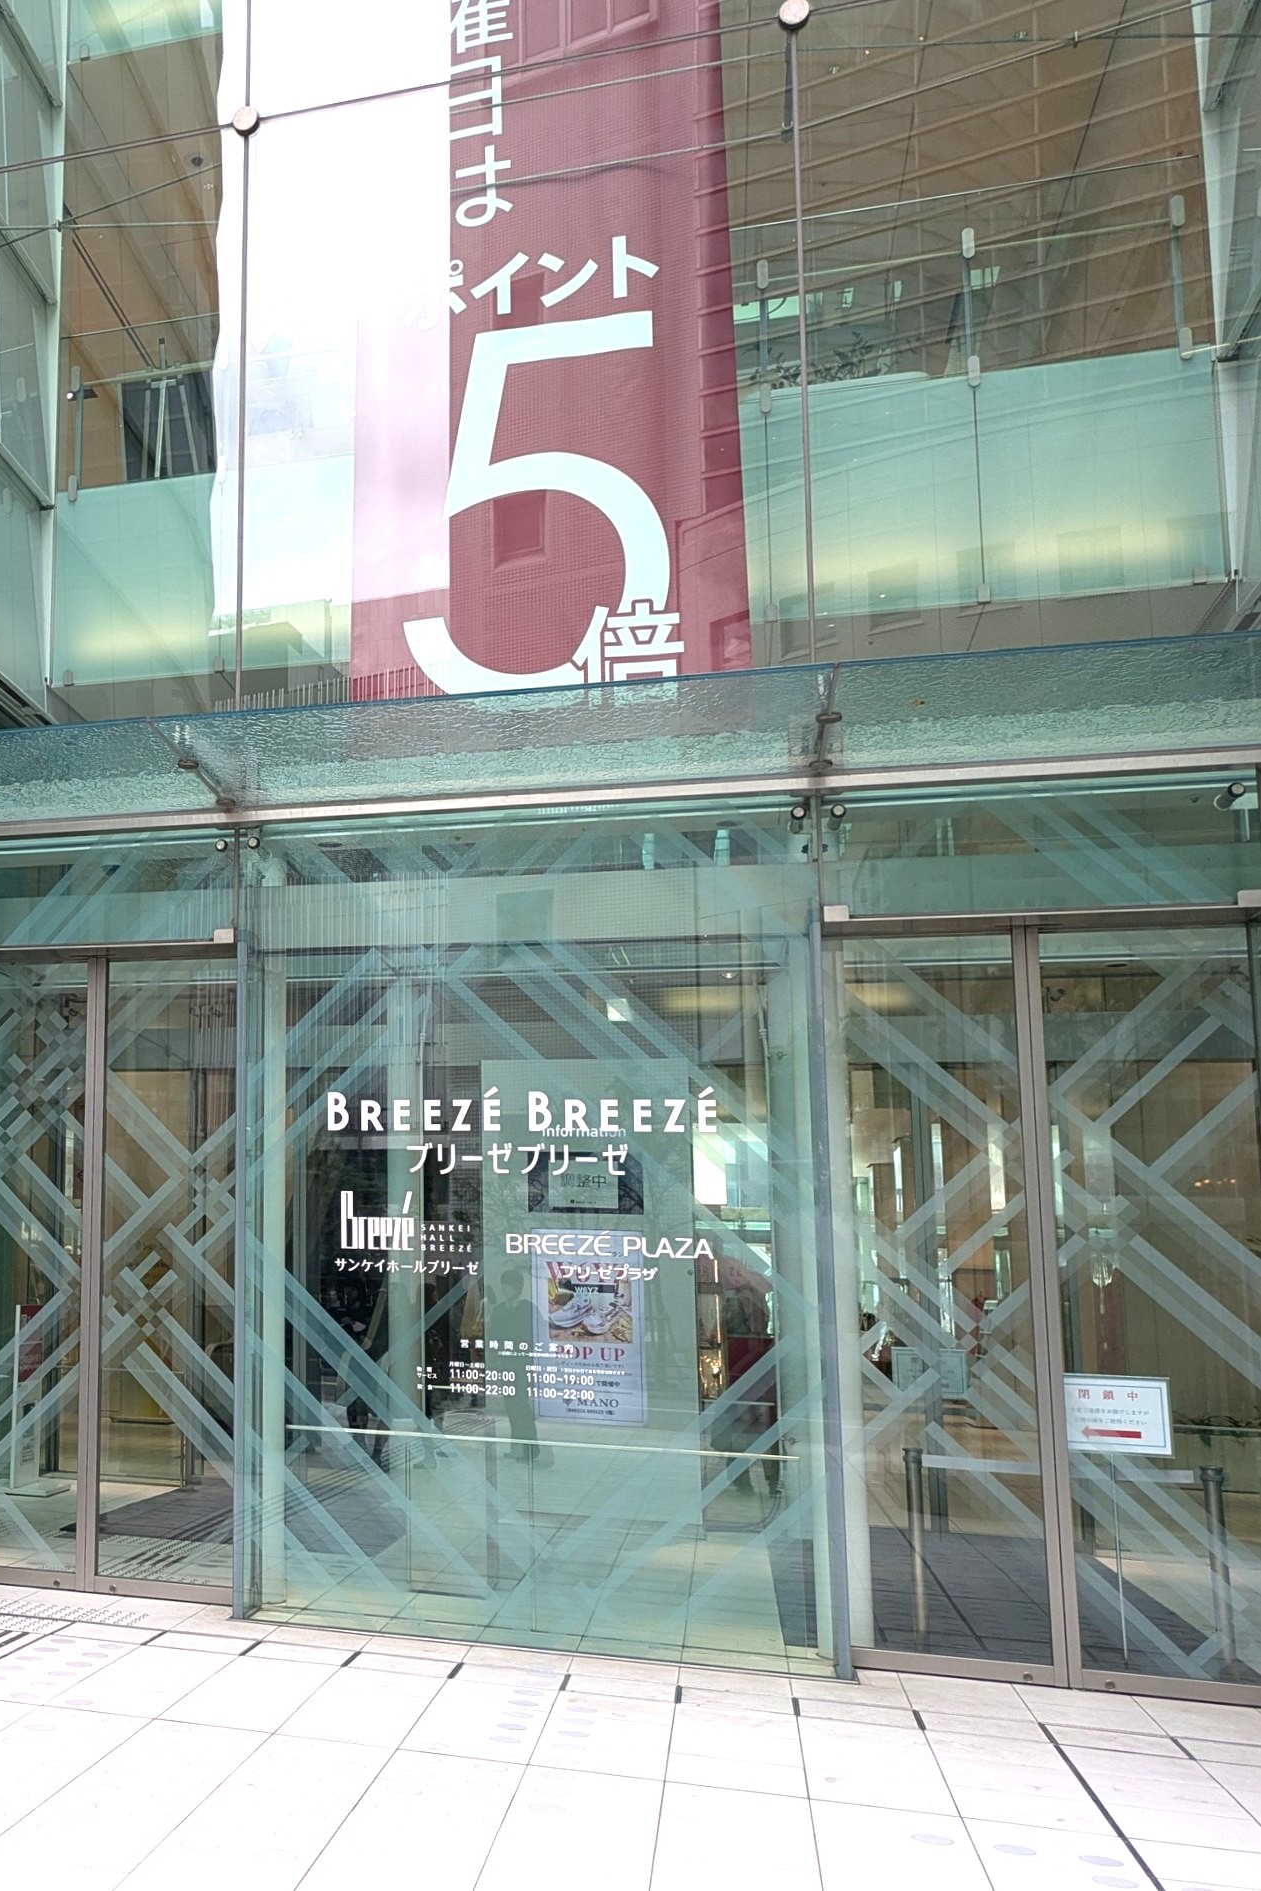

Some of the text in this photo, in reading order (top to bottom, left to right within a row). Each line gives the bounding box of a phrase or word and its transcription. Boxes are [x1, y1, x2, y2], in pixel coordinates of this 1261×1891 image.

[326, 1086, 718, 1133] BREEZÉ BREEZÉ
[406, 1142, 629, 1177] ブリーゼブリーゼ
[560, 1173, 607, 1189] 調整中
[420, 1223, 471, 1232] SANKEI
[420, 1234, 455, 1242] HALL
[505, 1230, 612, 1257] BREEZÉ
[623, 1236, 715, 1260] PLAZA
[334, 1257, 479, 1275] サンケイホールブリーゼ
[559, 1263, 659, 1281] ブリーゼプラザ
[459, 1339, 574, 1353] 営業時間のご案内
[601, 1347, 626, 1362] UP
[577, 1398, 620, 1409] MANO
